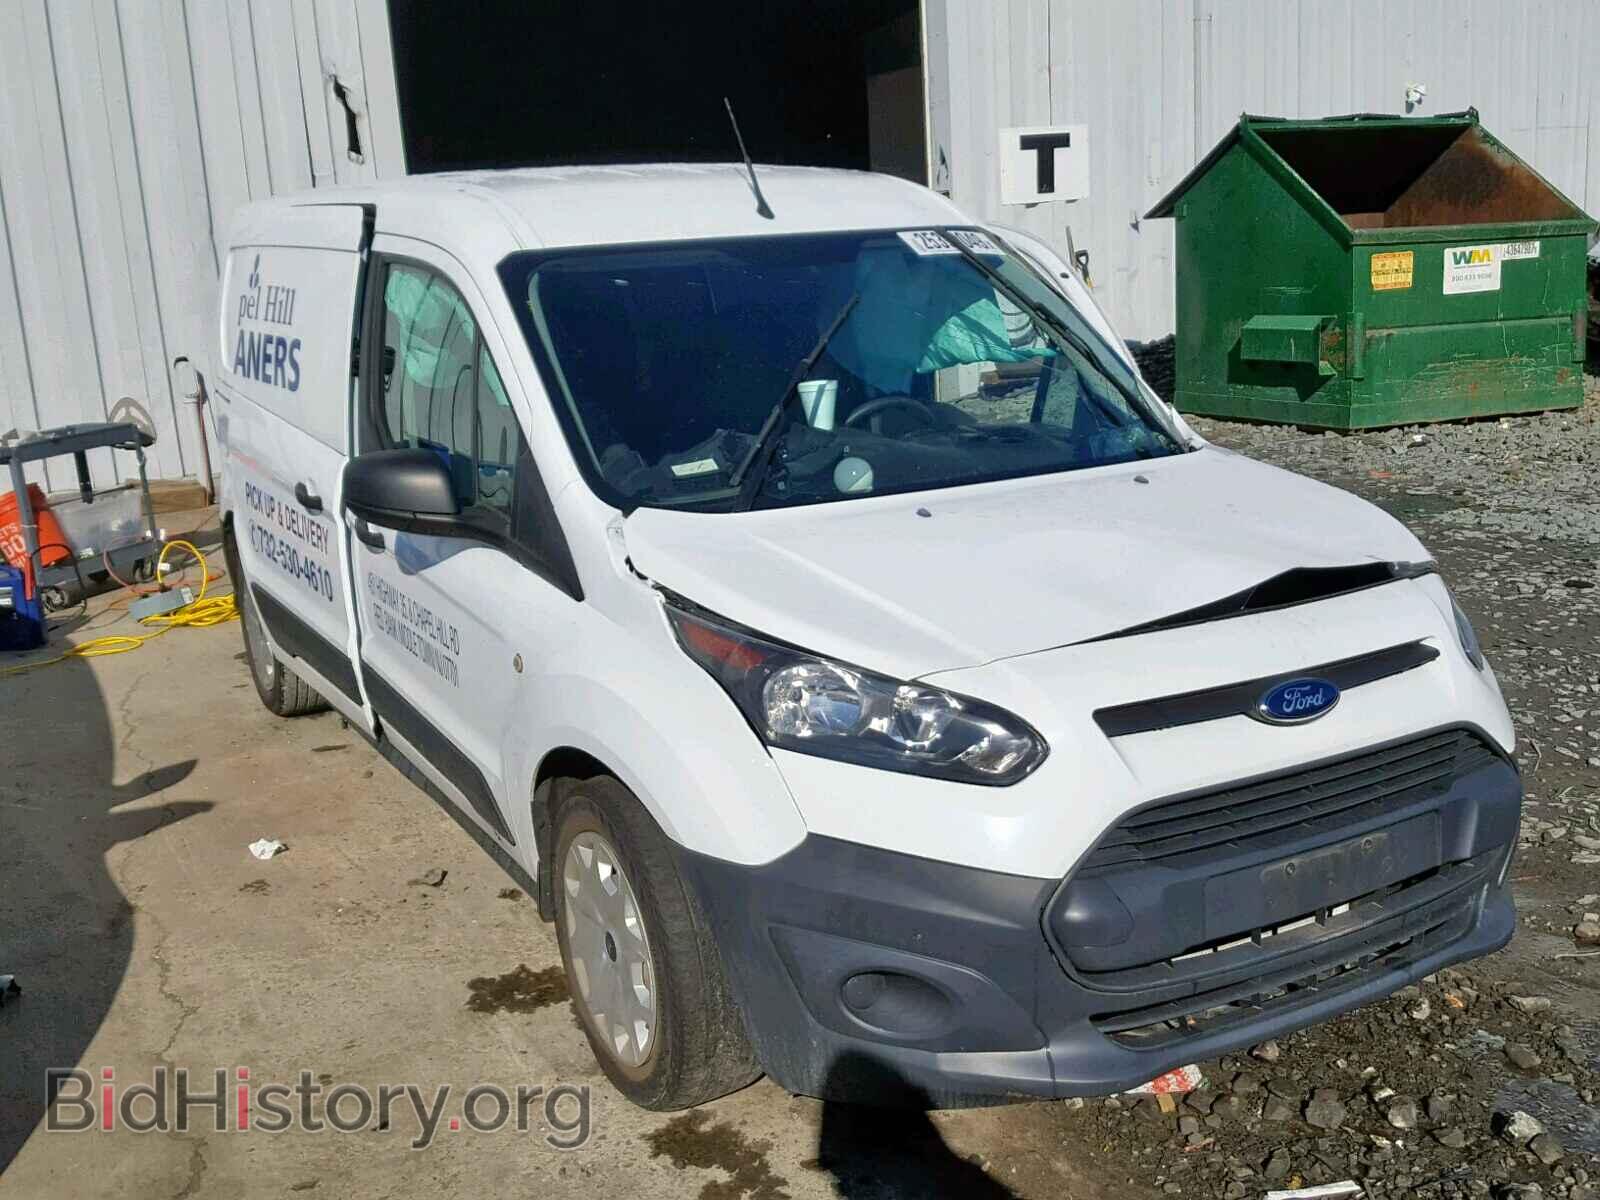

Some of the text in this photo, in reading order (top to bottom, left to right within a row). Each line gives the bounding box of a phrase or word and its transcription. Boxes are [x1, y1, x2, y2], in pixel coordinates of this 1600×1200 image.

[1019, 132, 1071, 194] T
[1452, 248, 1491, 265] WM
[264, 285, 296, 325] Hill
[232, 329, 302, 392] ANERS
[245, 481, 329, 556] PICK UP & DELIVERY
[257, 525, 333, 602] 732-530-4610
[1282, 685, 1325, 712] Ford
